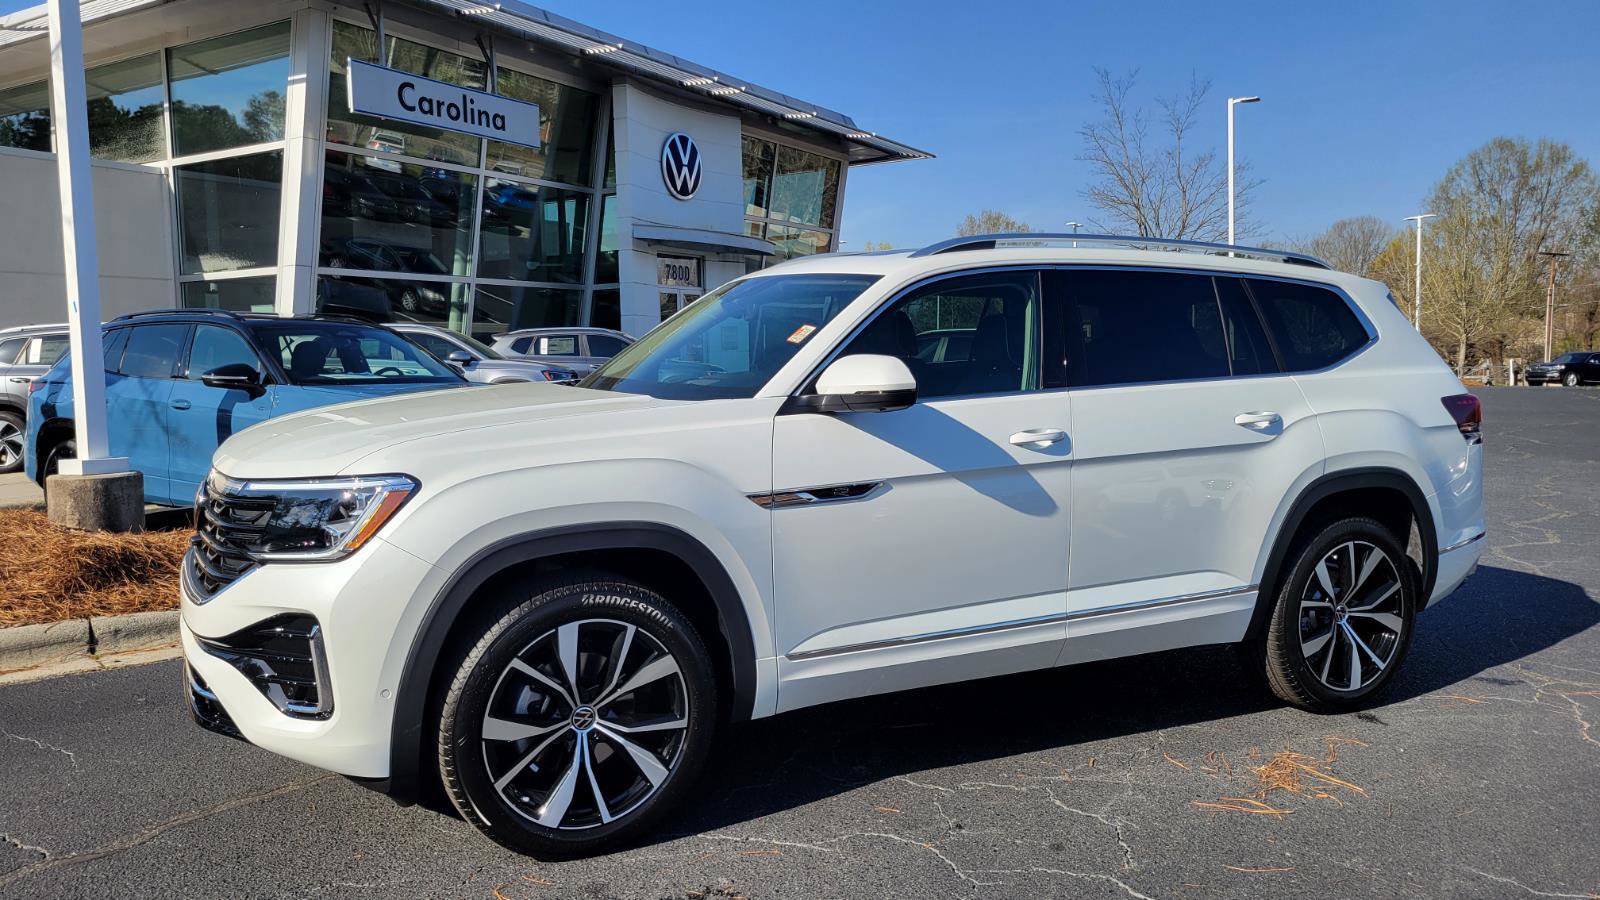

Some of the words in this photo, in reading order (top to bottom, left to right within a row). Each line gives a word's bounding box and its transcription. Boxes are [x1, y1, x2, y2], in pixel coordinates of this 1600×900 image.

[397, 82, 506, 132] Carolina
[663, 133, 702, 198] VW
[665, 263, 690, 281] 7800
